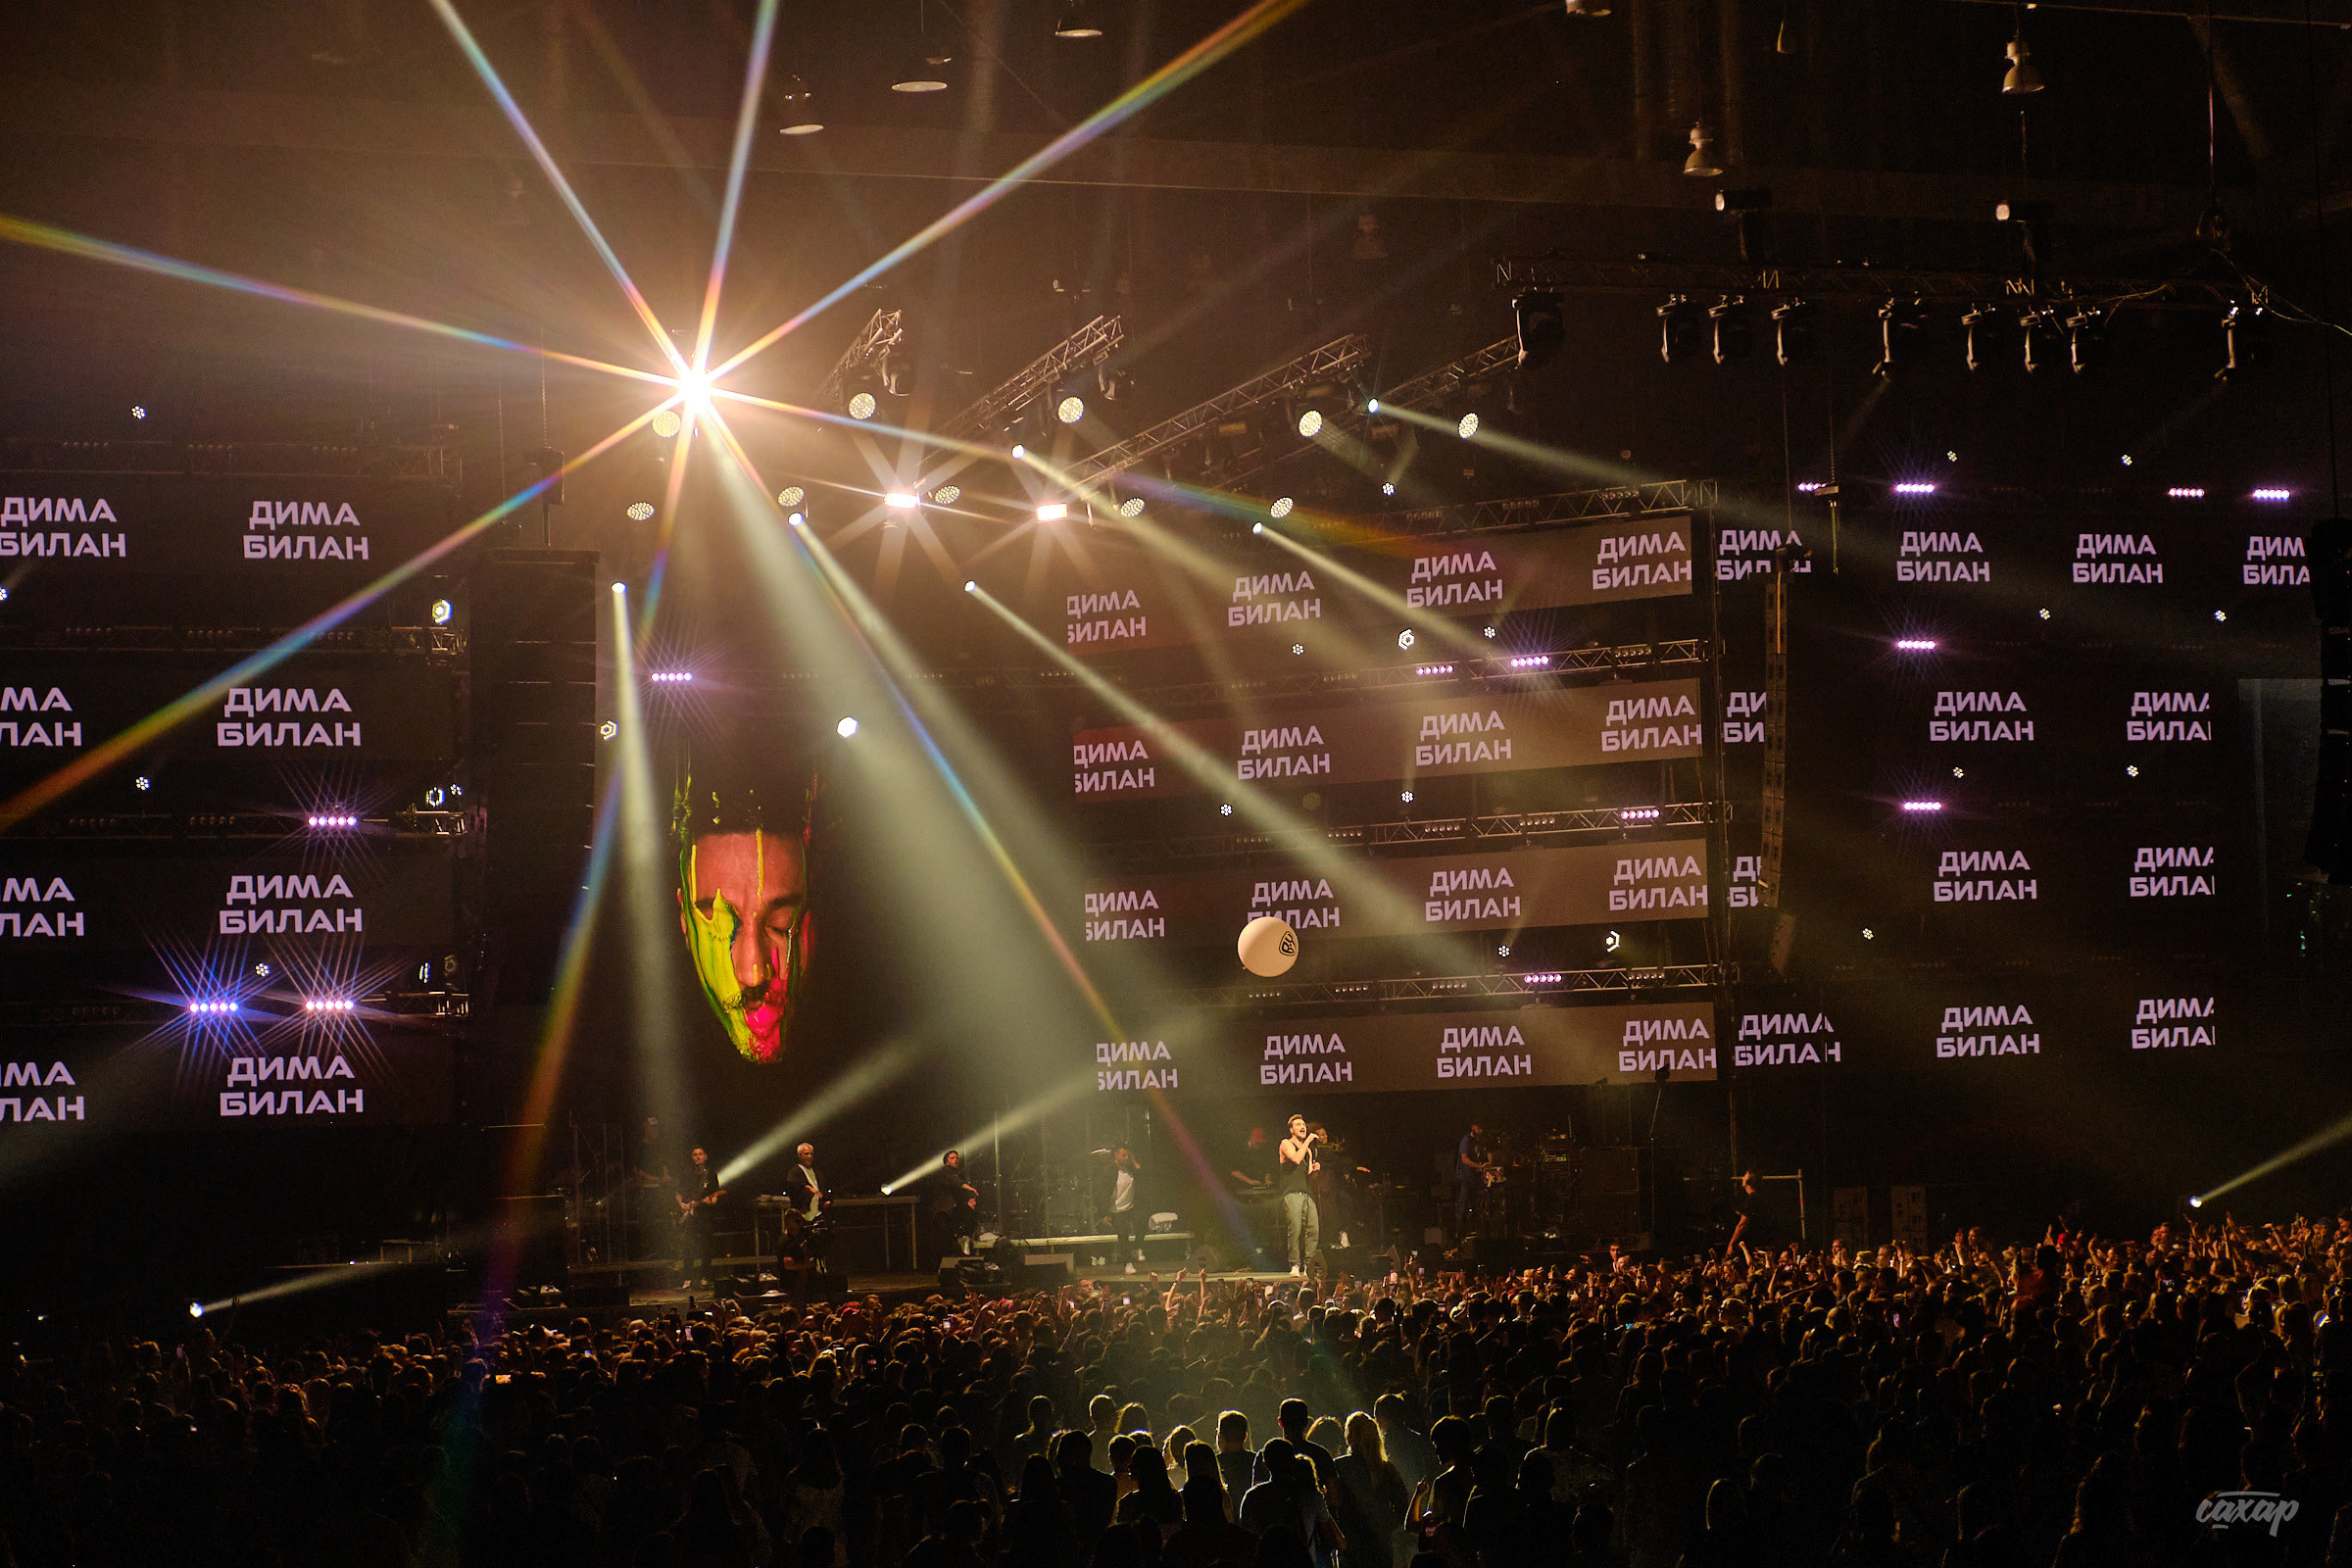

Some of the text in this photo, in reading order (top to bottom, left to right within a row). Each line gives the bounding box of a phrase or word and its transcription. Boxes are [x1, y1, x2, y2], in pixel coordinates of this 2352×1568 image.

[1, 497, 117, 527] ДИМА
[249, 501, 360, 530] ДИМА
[0, 532, 125, 557] БИЛАН
[244, 535, 368, 560] БИЛАН
[1597, 532, 1686, 564] ДИМА
[1720, 530, 1801, 555] ДИМА
[1901, 532, 1983, 557] ДИМА
[2077, 534, 2156, 559] ДИМА
[2247, 536, 2305, 561] ДИМ
[1412, 552, 1496, 583] ДИМА
[1592, 560, 1691, 590] БИЛАН
[1896, 561, 1989, 581] БИЛАН
[2073, 563, 2163, 583] БИЛАН
[1233, 571, 1314, 603] ДИМА
[1406, 578, 1503, 609] БИЛАН
[1229, 599, 1320, 626] БИЛАН
[224, 688, 352, 717] ДИМА
[1606, 696, 1695, 726] ДИМА
[1935, 692, 2027, 716] ДИМА
[218, 723, 361, 746] БИЛАН
[1420, 710, 1504, 741] ДИМА
[1601, 724, 1701, 752] БИЛАН
[1930, 721, 2034, 741] БИЛАН
[2127, 721, 2211, 741] БИЛА
[1242, 725, 1324, 756] ДИМА
[1416, 739, 1511, 765] БИЛАН
[1238, 754, 1330, 780] БИЛАН
[1614, 856, 1701, 885] ДИМА
[1938, 851, 2031, 877] ДИМА
[226, 874, 353, 905] ДИМА
[1252, 879, 1334, 907] ДИМА
[1430, 868, 1514, 897] ДИМА
[1934, 880, 2036, 902] БИЛАН
[2130, 876, 2215, 897] БИЛА
[1426, 897, 1520, 921] БИЛАН
[1609, 885, 1707, 910] БИЛАН
[220, 908, 363, 934] БИЛАН
[1739, 1013, 1834, 1041] ДИМА
[1941, 1005, 2033, 1033] ДИМА
[1442, 1026, 1525, 1054] ДИМА
[1623, 1019, 1709, 1047] ДИМА
[1936, 1034, 2039, 1057] БИЛАН
[2132, 1026, 2215, 1049] БИЛА
[1264, 1034, 1346, 1060] ДИМА
[1619, 1049, 1716, 1071] БИЛАН
[1735, 1042, 1840, 1066] БИЛАН
[0, 1061, 75, 1086] МА
[227, 1055, 355, 1087] ДИМА
[1260, 1061, 1352, 1084] БИЛАН
[1438, 1054, 1531, 1078] БИЛАН
[220, 1089, 364, 1116] БИЛАН
